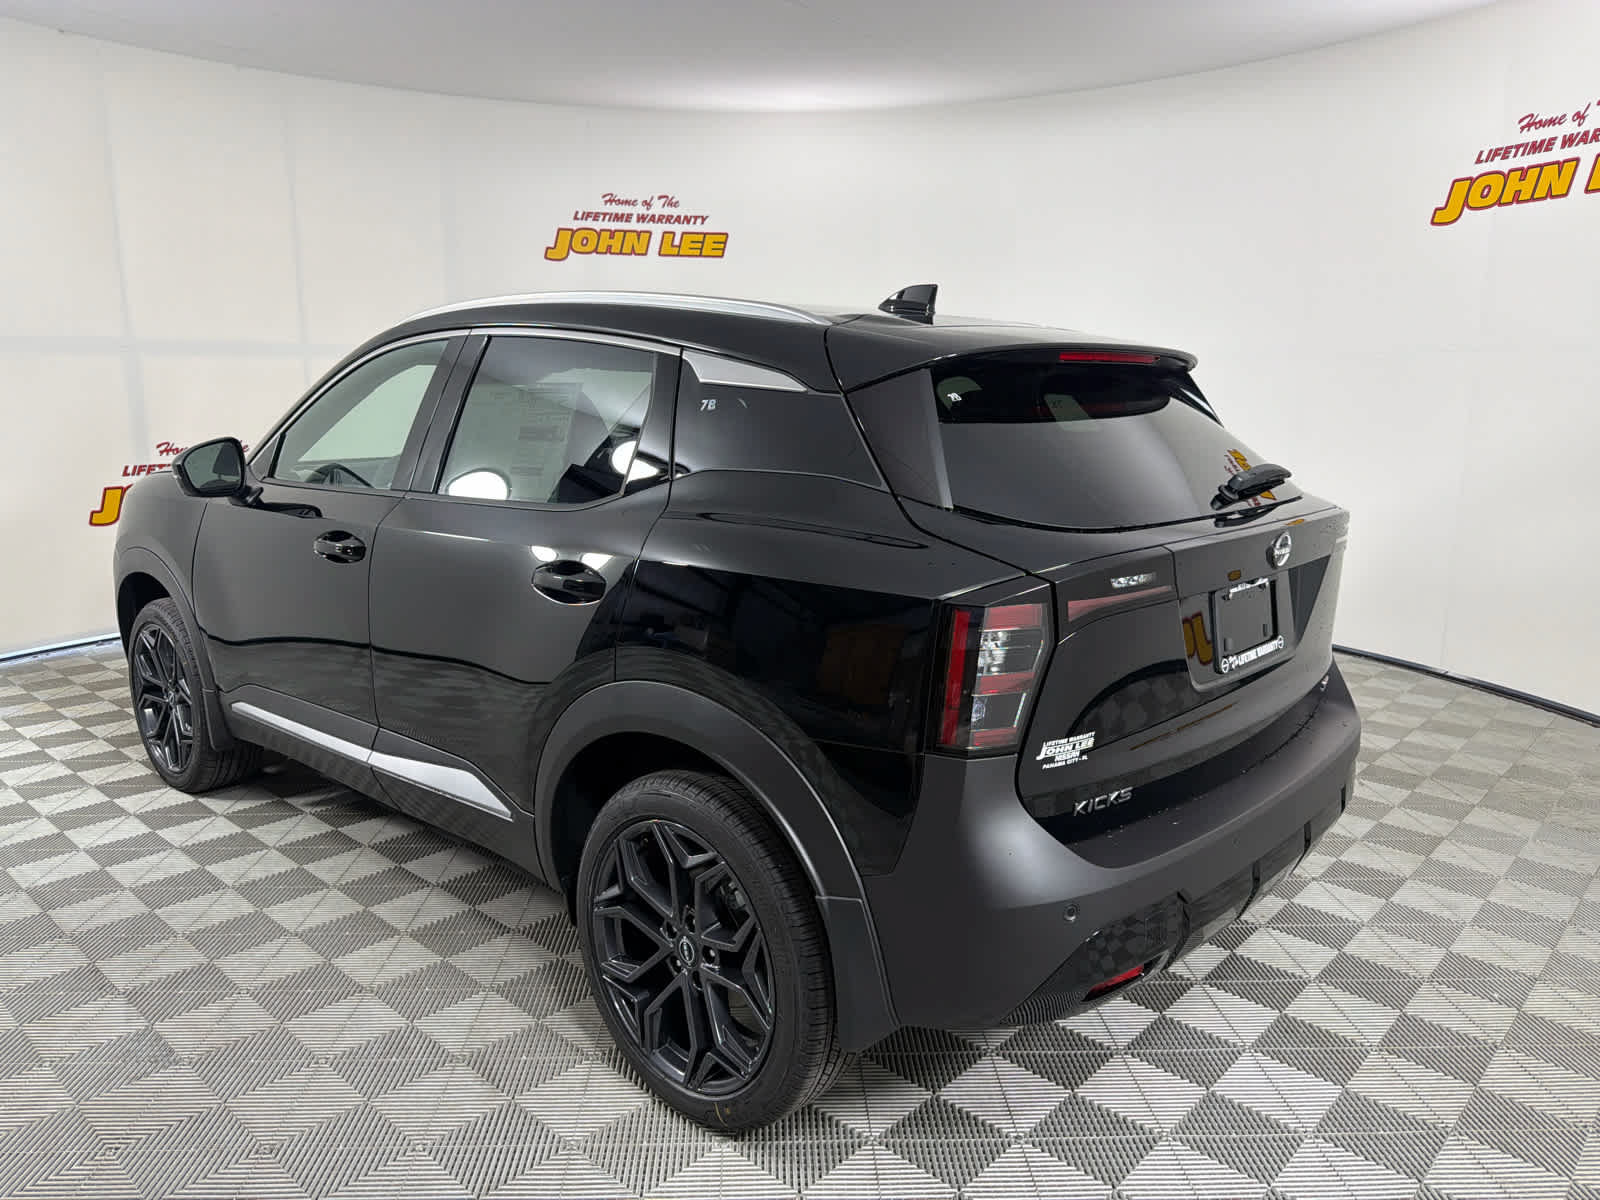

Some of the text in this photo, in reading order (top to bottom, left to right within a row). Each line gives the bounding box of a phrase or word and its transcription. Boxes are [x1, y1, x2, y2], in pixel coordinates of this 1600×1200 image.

[1517, 102, 1591, 133] Home of
[1474, 136, 1558, 164] LIFETIME
[602, 193, 680, 211] Home of The
[1430, 157, 1580, 226] JOHN
[573, 211, 709, 225] LIFETIME WARRANTY
[544, 227, 729, 261] JOHN LEE
[1036, 737, 1095, 760] JOHN LEE
[1046, 731, 1096, 747] LIFETIME WARRANTY
[1042, 760, 1066, 770] PANAMA
[1066, 757, 1078, 765] CITY
[1073, 786, 1134, 817] KICKS
